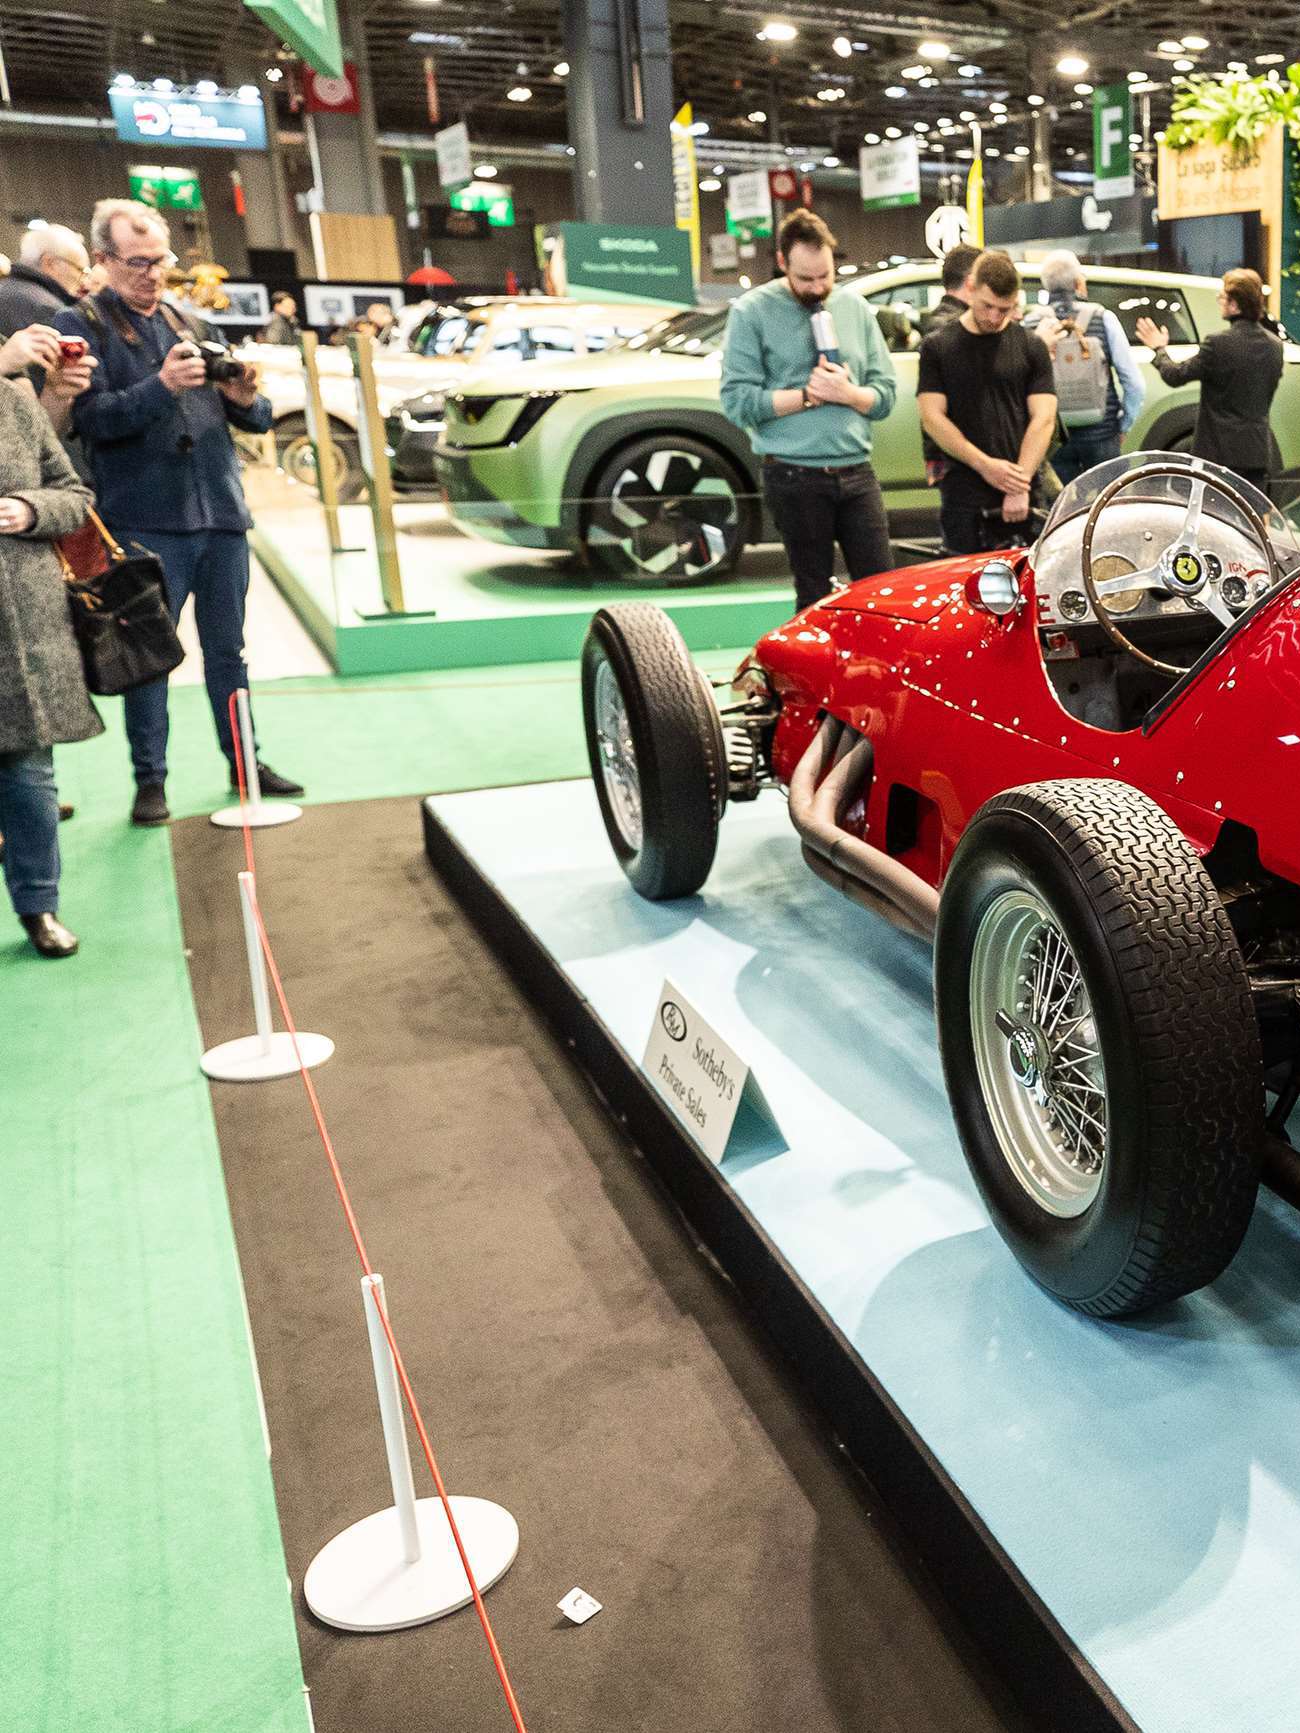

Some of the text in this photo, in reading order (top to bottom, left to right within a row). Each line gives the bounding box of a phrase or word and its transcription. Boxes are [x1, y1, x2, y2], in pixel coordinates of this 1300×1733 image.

[1101, 106, 1124, 168] F
[658, 1052, 708, 1129] Private Sales
[692, 1036, 736, 1102] Sotheby's
